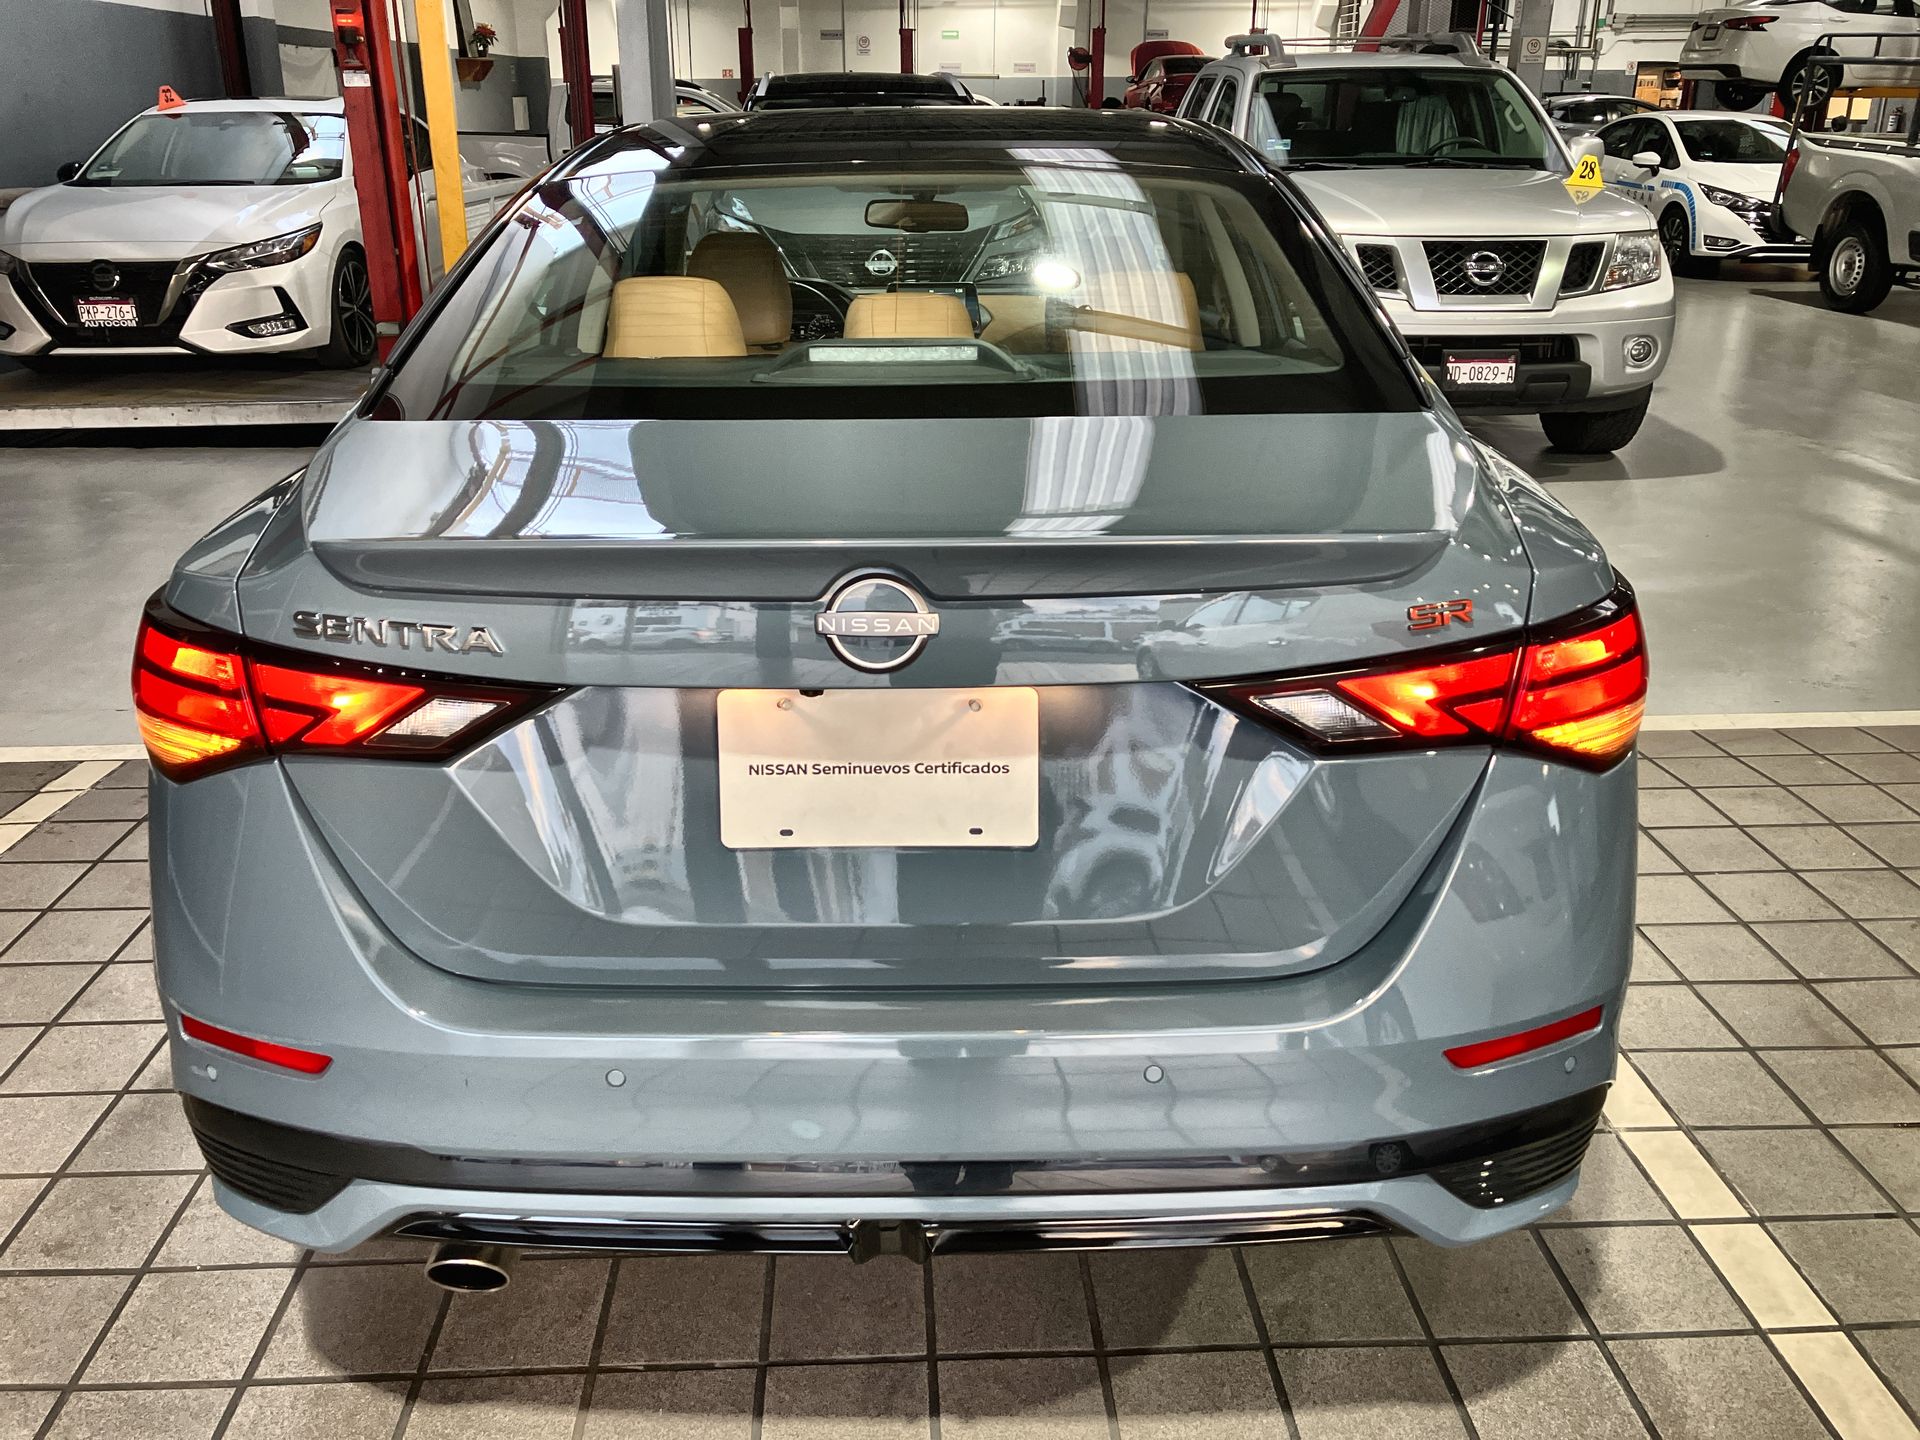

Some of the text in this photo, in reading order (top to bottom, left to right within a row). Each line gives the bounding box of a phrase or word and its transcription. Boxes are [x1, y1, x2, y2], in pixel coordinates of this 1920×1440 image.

[161, 89, 175, 103] 32
[1579, 160, 1597, 180] 28
[84, 320, 137, 328] AUTOCOM
[1406, 599, 1474, 631] SR
[818, 617, 937, 633] NISSAN
[293, 610, 504, 657] SENTRA
[748, 761, 1010, 776] NISSAN Seminuevos Certificados
